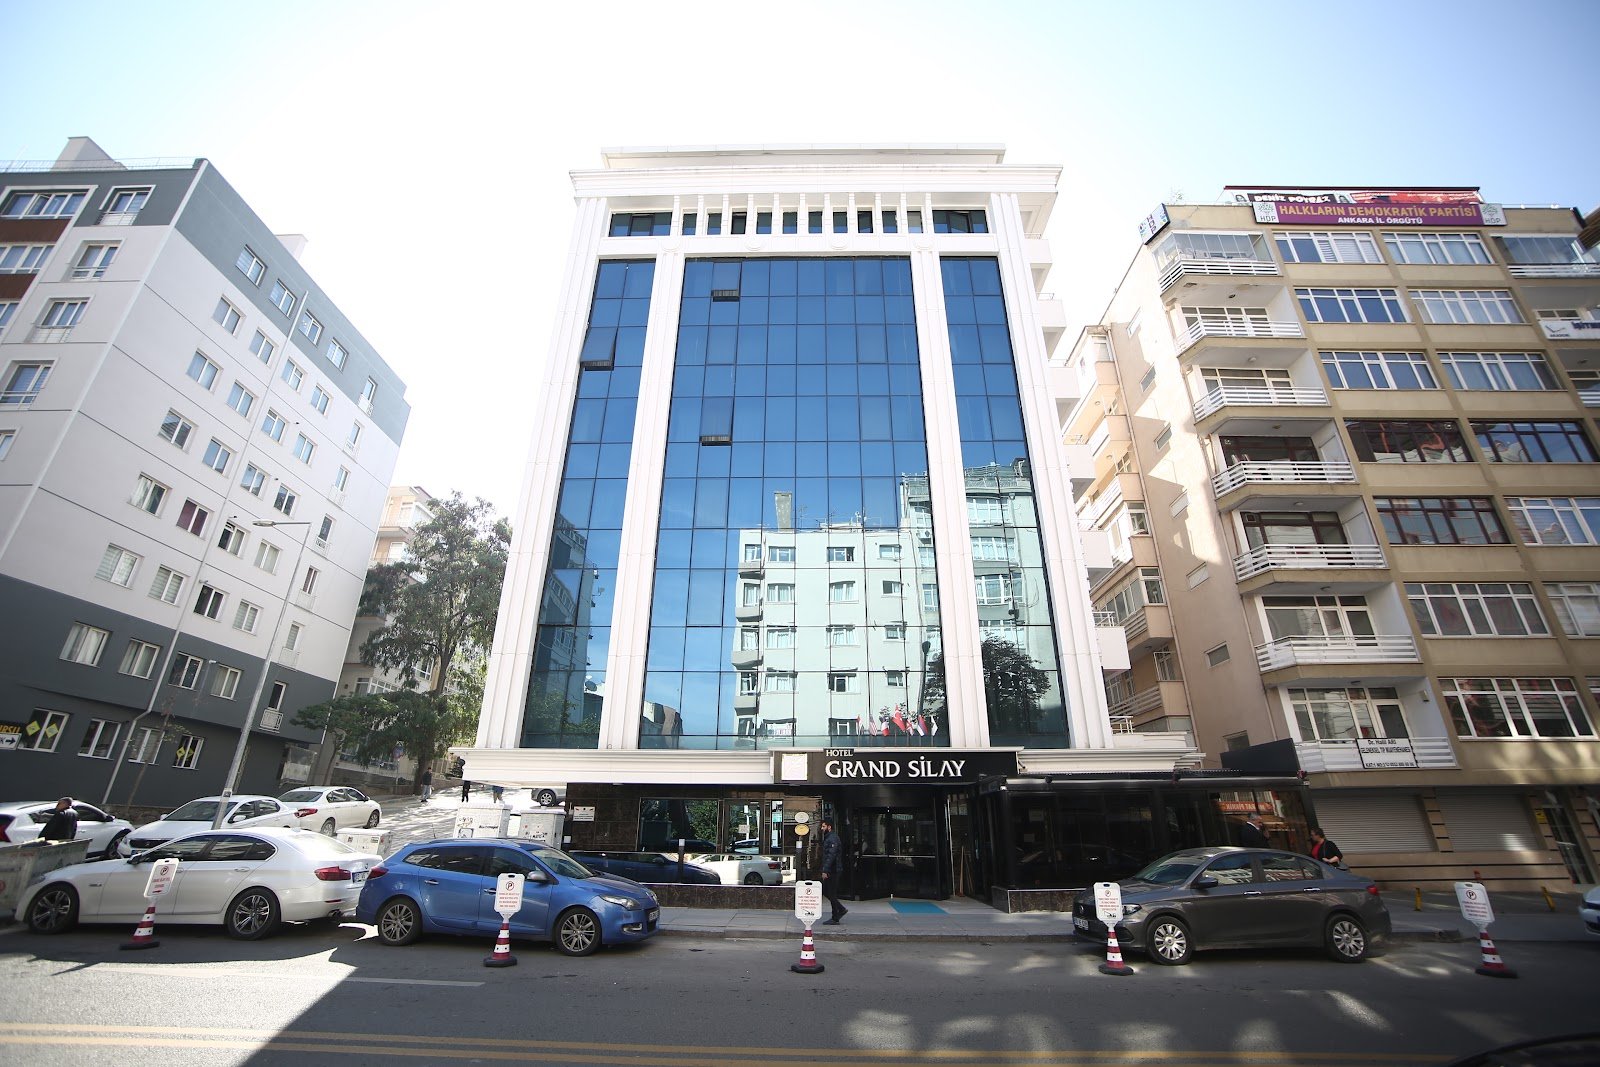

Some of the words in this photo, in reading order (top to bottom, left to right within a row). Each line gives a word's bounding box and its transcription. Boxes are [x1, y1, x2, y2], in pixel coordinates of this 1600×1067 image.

[1279, 205, 1345, 216] HALKLARIN
[1349, 205, 1427, 217] DEMOKRATİK
[1430, 205, 1477, 217] PARTİSİ
[1386, 216, 1423, 224] ÖRGÜTÜ
[825, 749, 854, 757] HOTEL
[825, 760, 901, 778] GRAND
[907, 755, 966, 778] SİLAY
